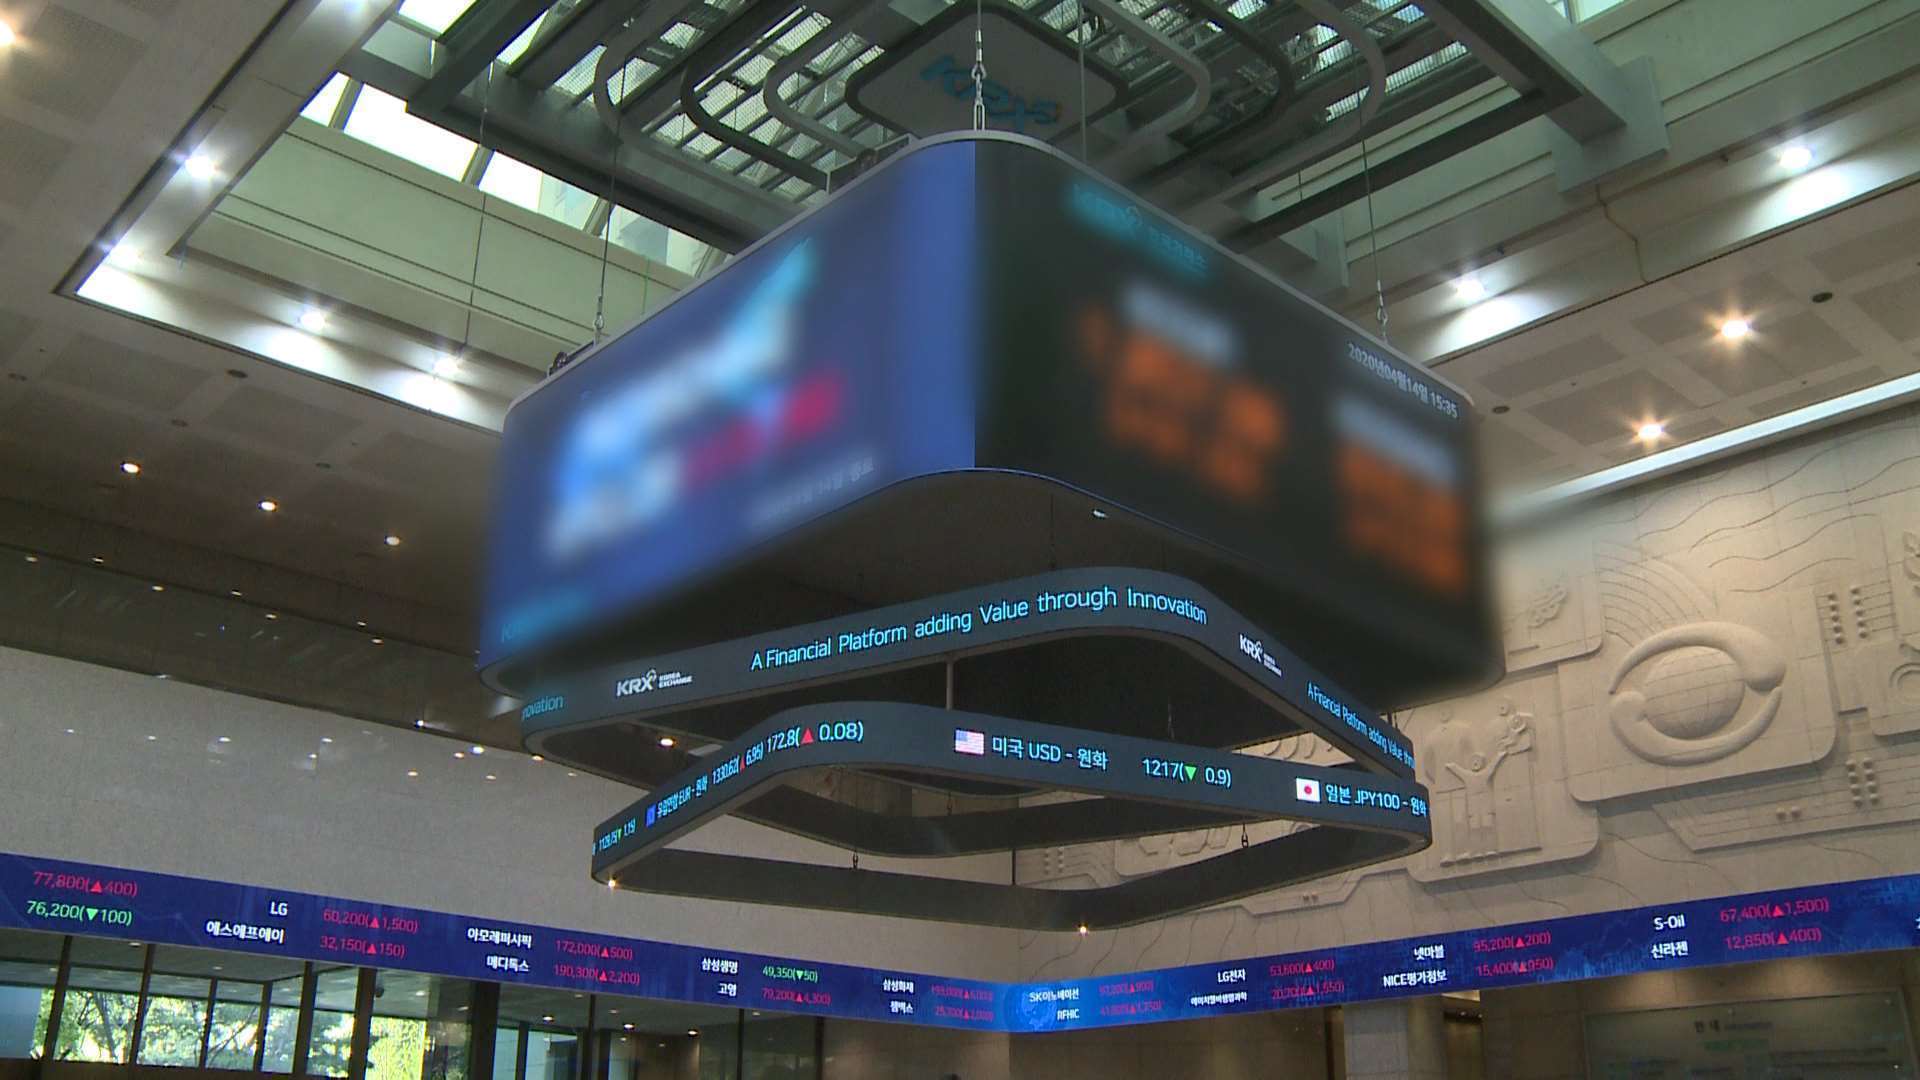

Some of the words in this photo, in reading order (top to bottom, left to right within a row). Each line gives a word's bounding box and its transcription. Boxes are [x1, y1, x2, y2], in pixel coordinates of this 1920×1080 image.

[750, 653, 763, 671] A
[766, 638, 831, 668] Financial
[838, 624, 907, 653] Platform
[915, 611, 972, 639] adding
[980, 599, 1028, 625] Value
[1036, 586, 1117, 612] through
[1127, 587, 1208, 625] Innovation
[1240, 633, 1262, 663] KRX
[616, 670, 652, 697] KRX
[1314, 685, 1340, 718] Financial
[1342, 704, 1368, 737] Platform
[1369, 727, 1387, 754] adding
[992, 736, 1024, 759] 미국
[1029, 742, 1061, 763] USD
[1077, 747, 1108, 771] 원화
[1325, 783, 1351, 805] 일본
[1355, 789, 1400, 810] JPY100
[1410, 796, 1427, 818] 원화
[269, 901, 288, 916] LG
[1654, 914, 1686, 931] S-Oil
[206, 920, 285, 945] 에스에프에이
[1414, 944, 1445, 961] 넷마블
[1651, 940, 1689, 959] 신라젠
[702, 957, 738, 974] 삼성생명
[1217, 968, 1246, 983] LG전자
[1383, 969, 1448, 987] NICE평가정보
[1029, 988, 1079, 1003] SK이노베이션
[1057, 1008, 1080, 1021] RFHIC
